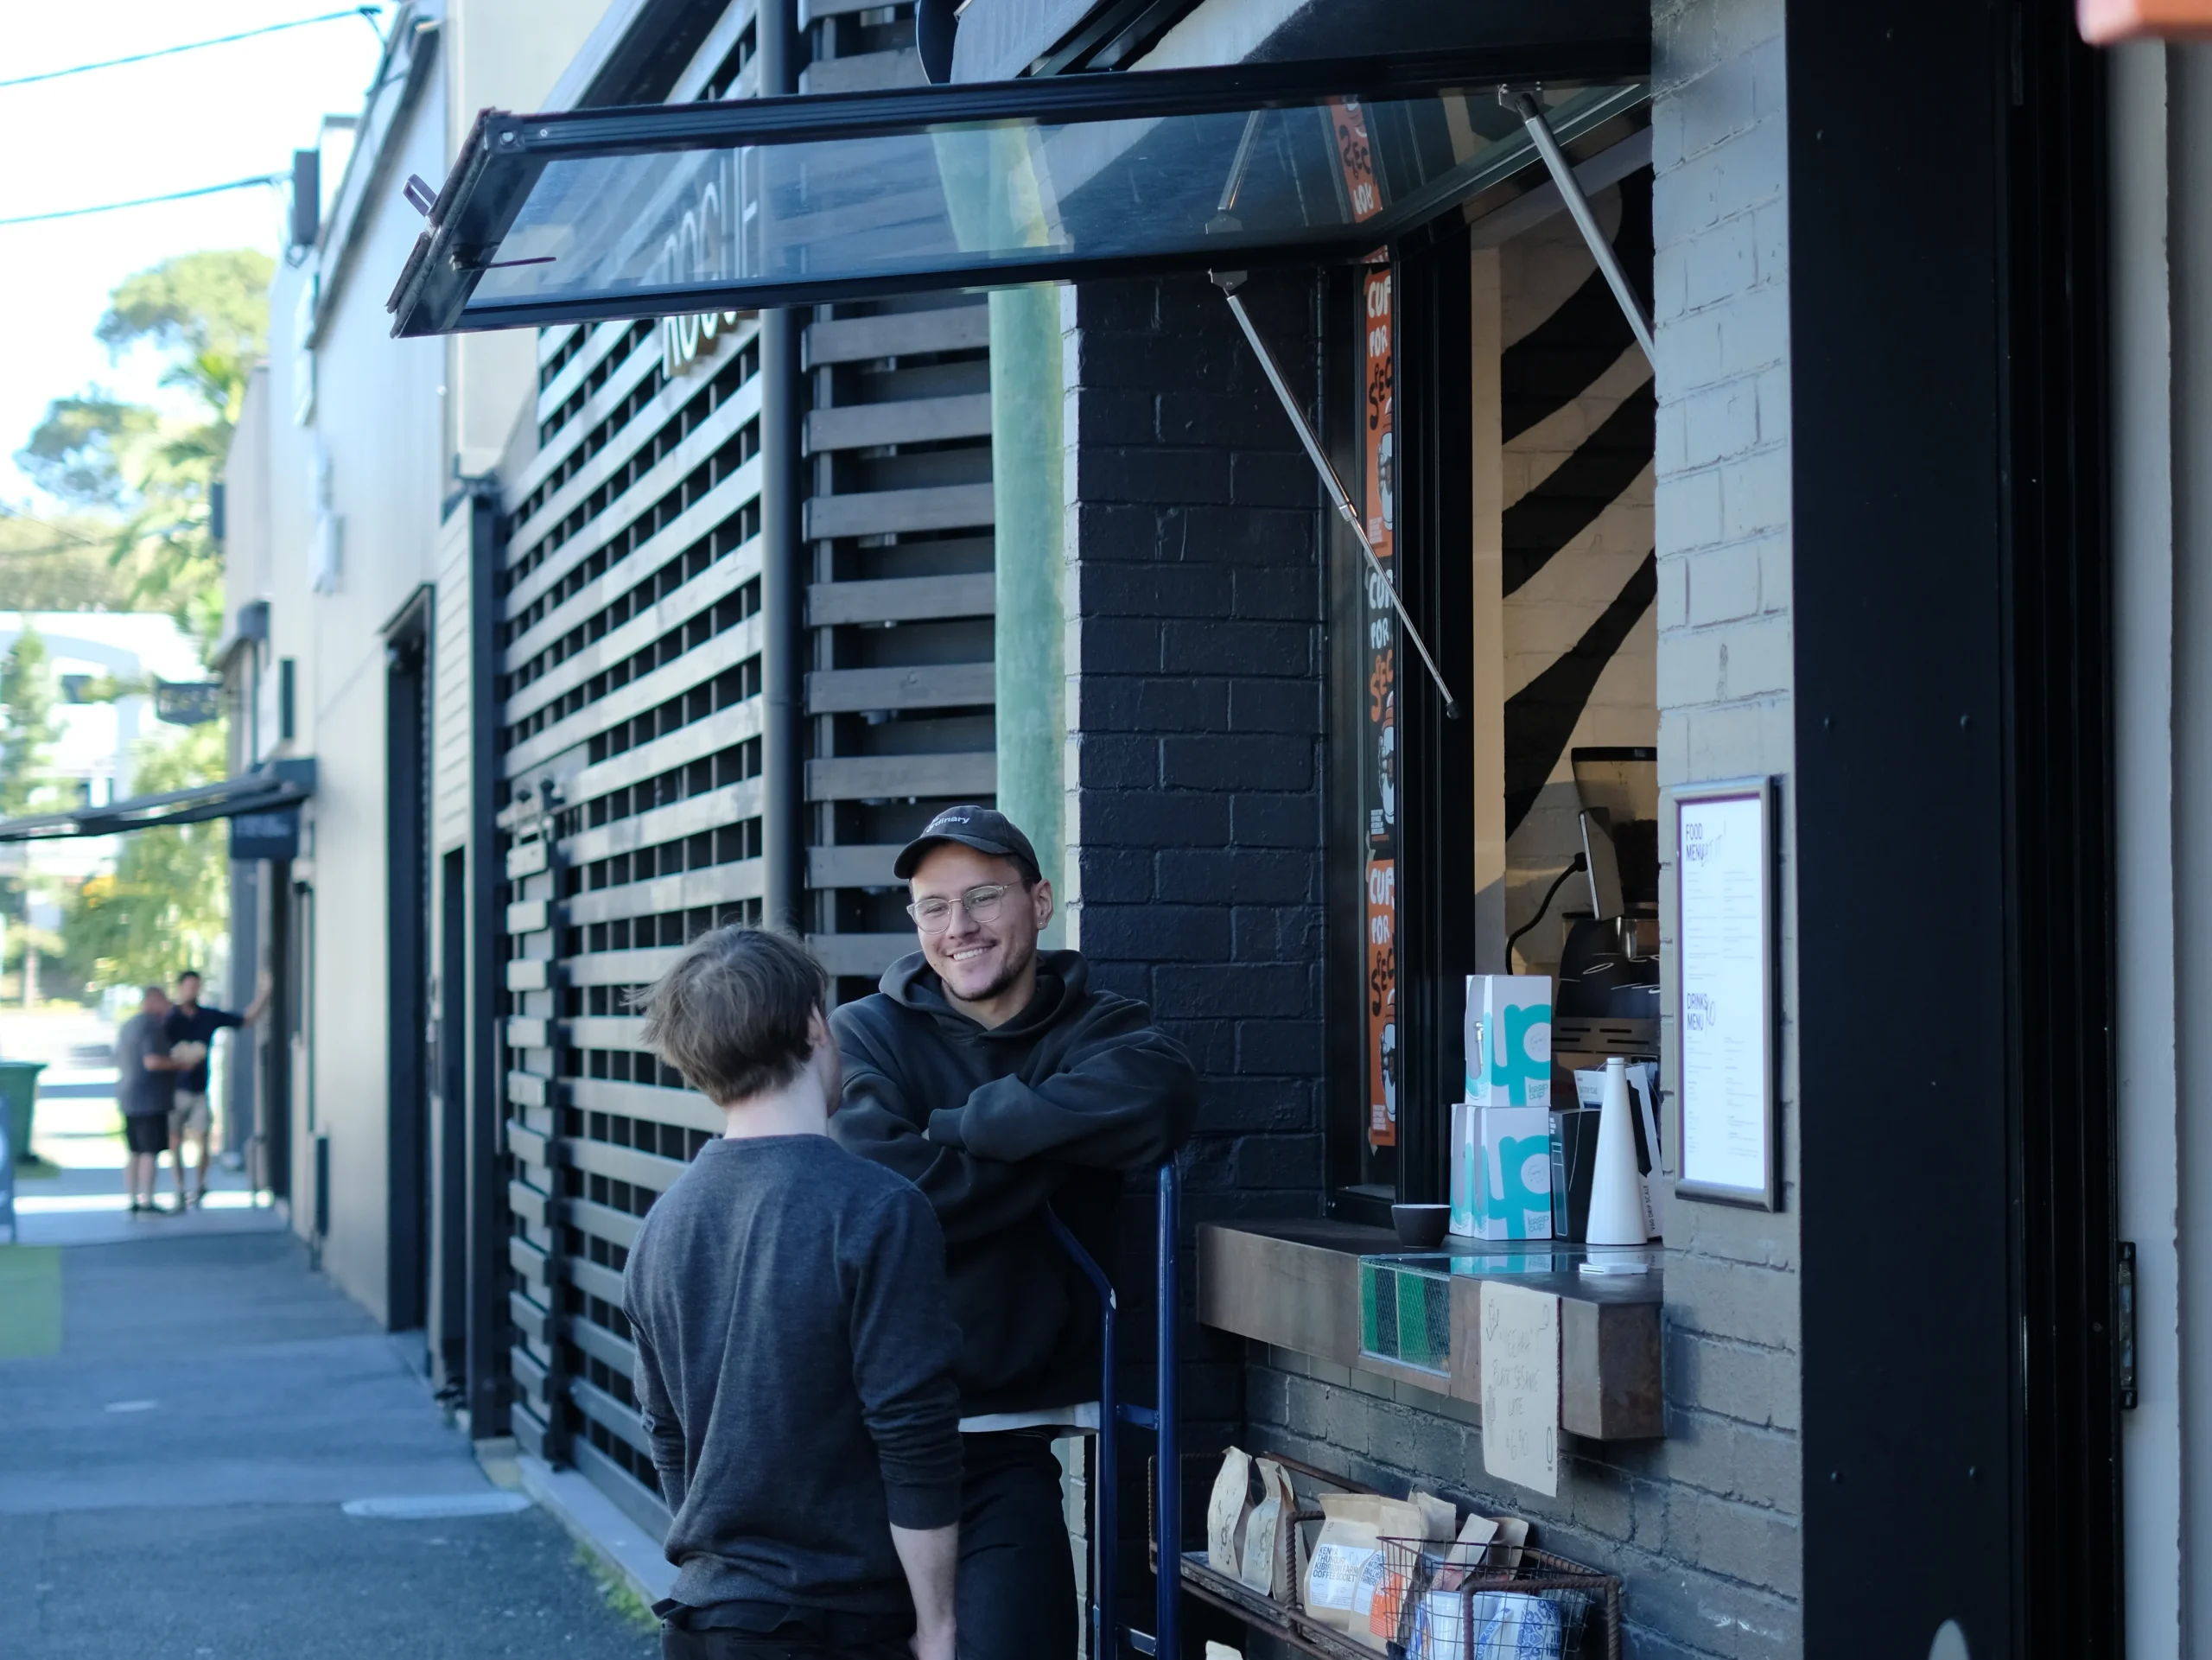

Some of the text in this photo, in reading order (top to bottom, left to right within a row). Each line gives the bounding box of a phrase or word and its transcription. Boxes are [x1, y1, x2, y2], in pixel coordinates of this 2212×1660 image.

[1369, 324, 1388, 358] FOR
[1370, 618, 1389, 650] FOR
[1686, 823, 1703, 841] FOOD
[1686, 843, 1704, 861] MENU
[1371, 915, 1390, 945] FOR
[1687, 993, 1707, 1010] DRINKS
[1687, 1013, 1704, 1031] MENU
[1643, 1185, 1651, 1204] SCALE
[1319, 1546, 1338, 1555] KENYA
[1313, 1569, 1357, 1582] COFFEE SOCIET
